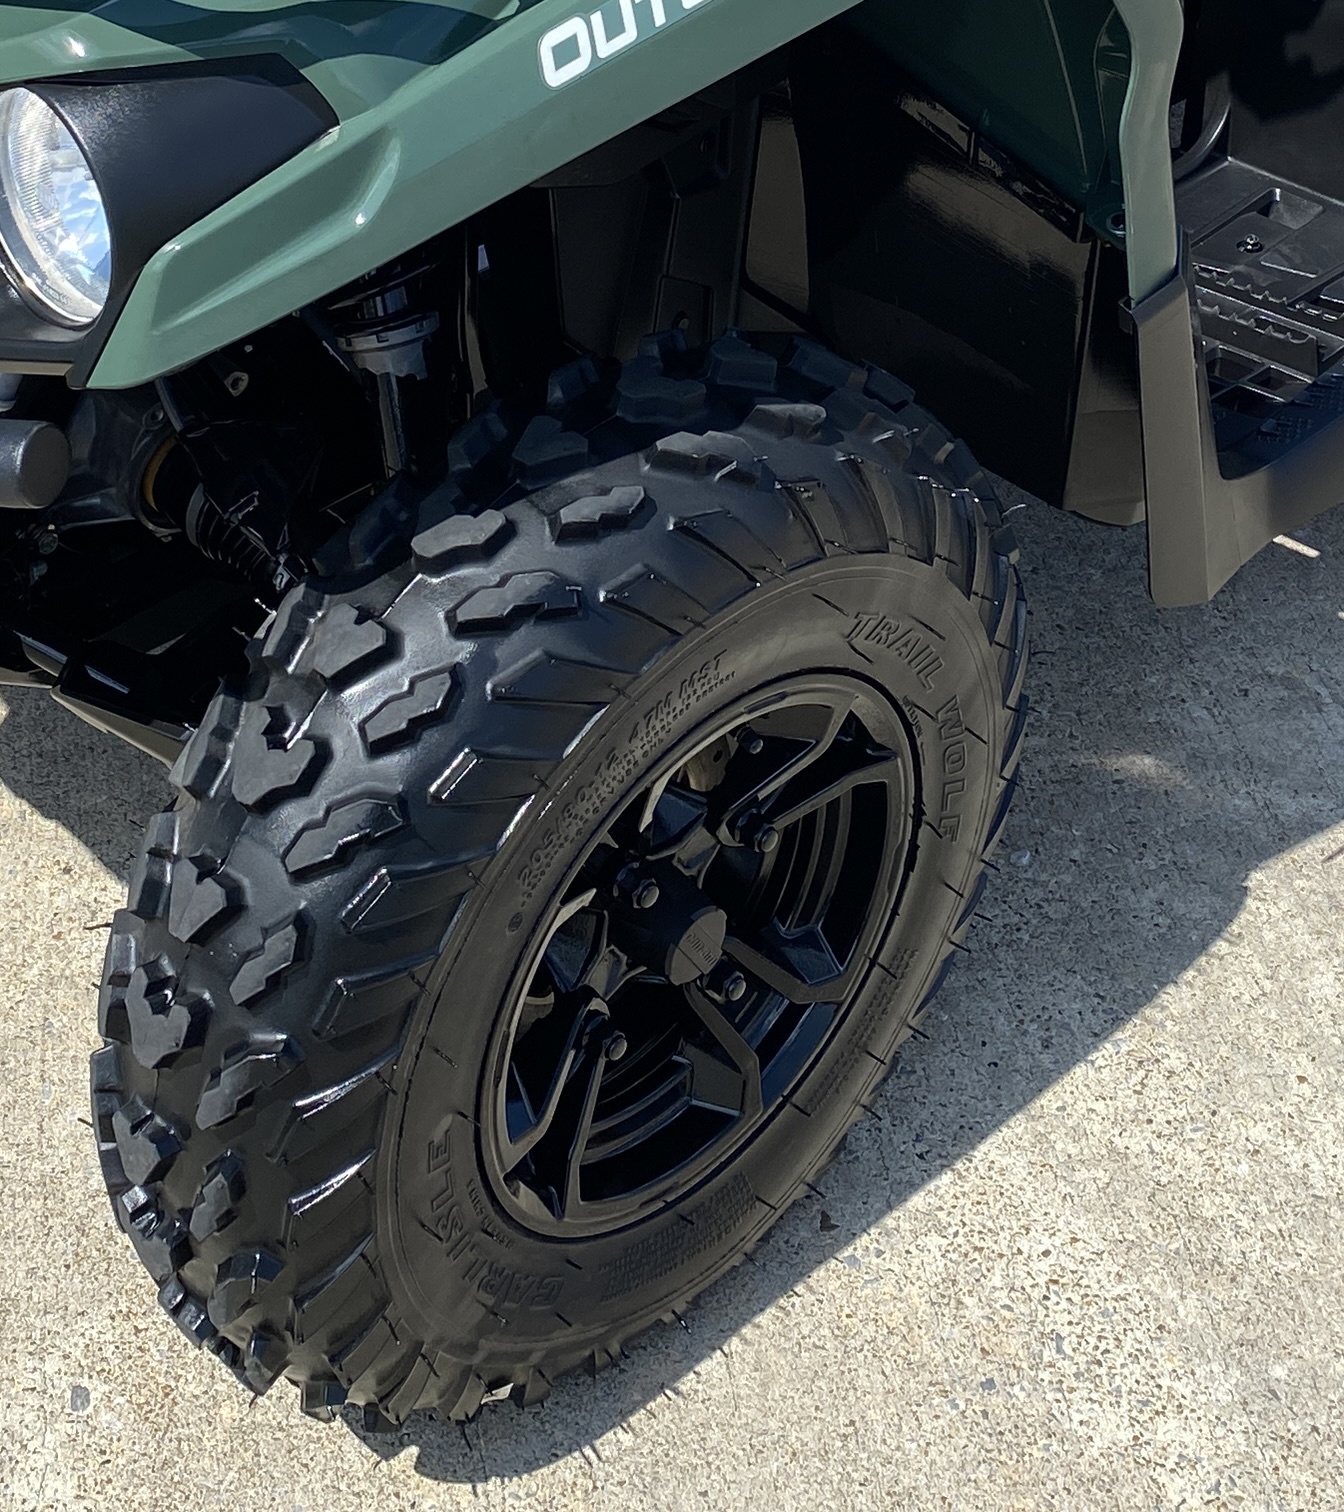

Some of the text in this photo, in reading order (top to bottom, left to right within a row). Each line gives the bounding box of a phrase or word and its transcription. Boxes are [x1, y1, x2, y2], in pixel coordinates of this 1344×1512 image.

[844, 610, 969, 844] TRAIL WOLF
[426, 1129, 566, 1311] CARLISLE
